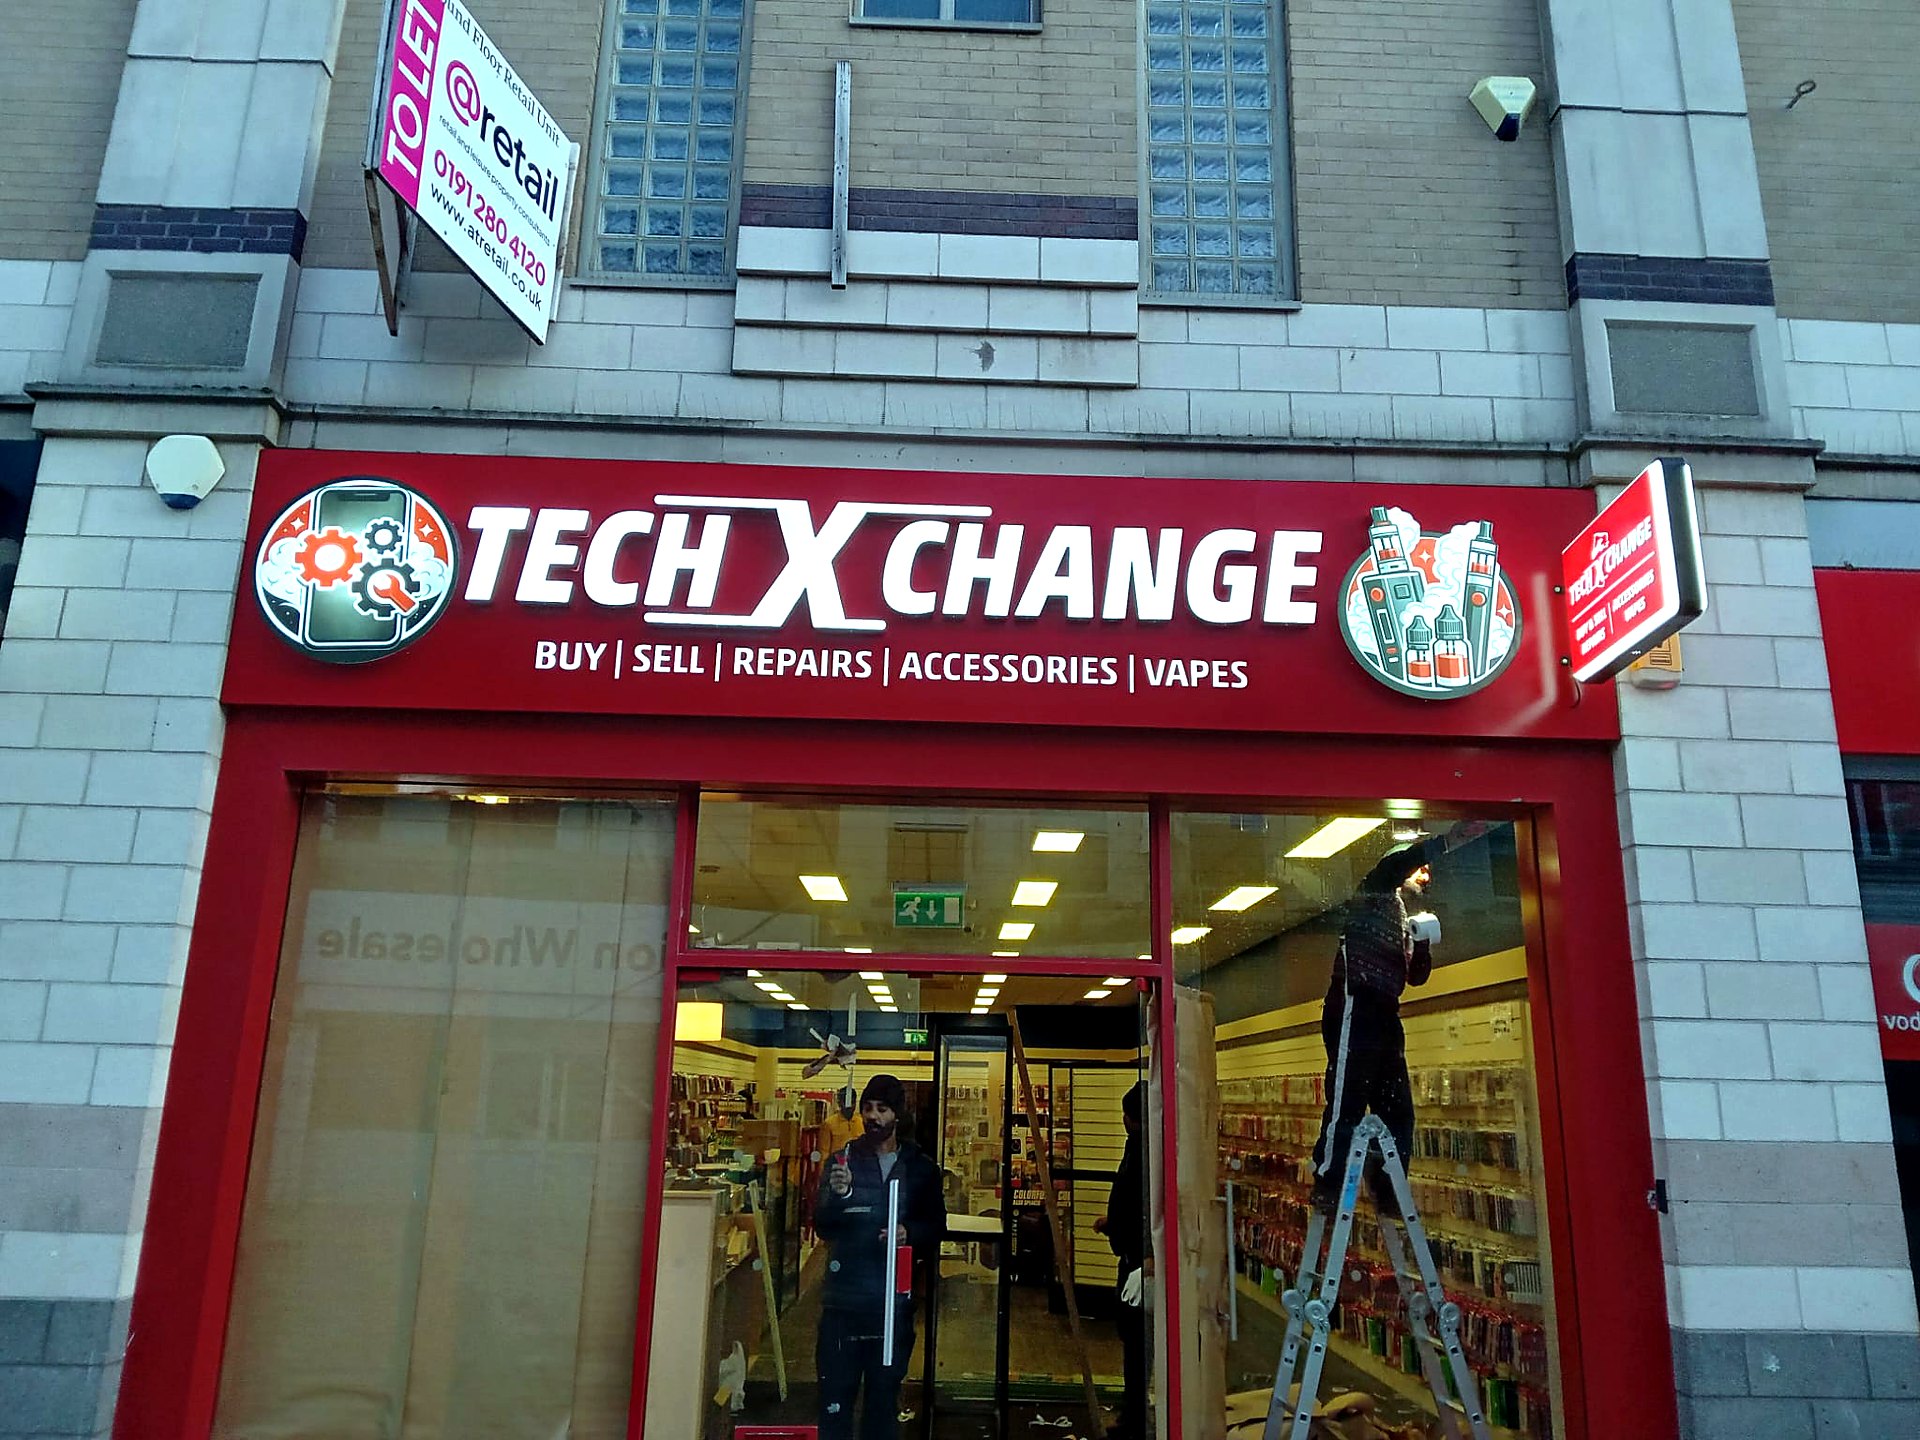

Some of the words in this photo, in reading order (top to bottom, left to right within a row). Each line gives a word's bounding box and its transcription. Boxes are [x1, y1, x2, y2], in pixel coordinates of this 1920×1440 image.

[398, 0, 438, 99] LET
[442, 0, 470, 36] und
[472, 26, 502, 75] Floor
[504, 68, 535, 117] Retail
[537, 104, 560, 148] Unit
[387, 93, 424, 178] TO
[439, 115, 457, 139] retail
[457, 135, 470, 155] and
[470, 147, 491, 178] leisure
[491, 175, 518, 210] property
[518, 205, 550, 247] consultants
[446, 60, 559, 222] @retail
[431, 182, 542, 311] www.atretail.co.uk
[434, 149, 473, 208] 0191
[473, 193, 507, 244] 280
[509, 235, 546, 287] 4120
[535, 641, 607, 671] BUY
[632, 644, 705, 674] SELL
[733, 647, 873, 678] REPAIRS
[899, 651, 1118, 685] ACCESSORIES
[1143, 658, 1249, 689] VAPES
